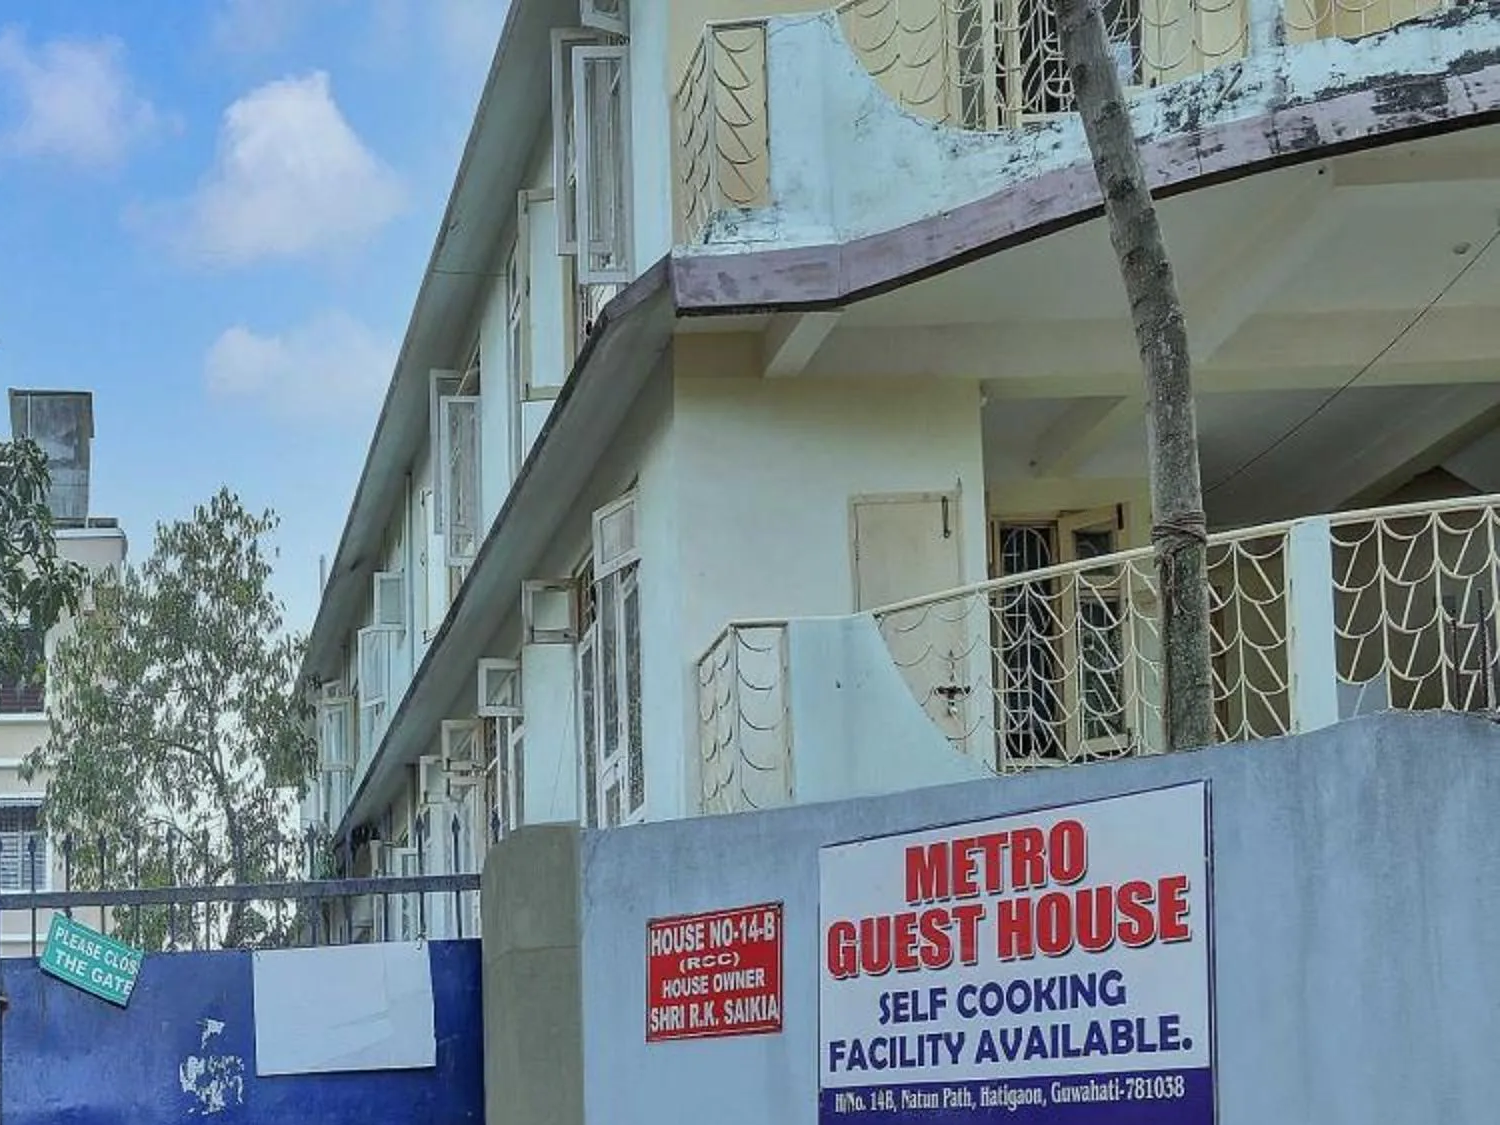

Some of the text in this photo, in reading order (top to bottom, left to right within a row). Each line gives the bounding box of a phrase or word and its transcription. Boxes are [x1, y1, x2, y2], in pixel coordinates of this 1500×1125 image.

[905, 819, 1088, 904] METRO
[54, 926, 140, 975] PLEASE CLOS
[651, 923, 704, 956] HOUSE
[827, 875, 1191, 979] GUEST HOUSE
[55, 948, 135, 995] THE GATE
[662, 968, 765, 998] HOUSE OWNER
[679, 951, 740, 973] (RCC)
[651, 1004, 685, 1032] SHRI
[724, 995, 778, 1024] SAIKIA
[878, 970, 1126, 1025] SELF COOKING
[829, 1015, 1193, 1072] FACILITY AVAILABLE.
[902, 1089, 938, 1109] Natun
[943, 1087, 976, 1110] Path,
[980, 1083, 1047, 1111] Hatigaon,
